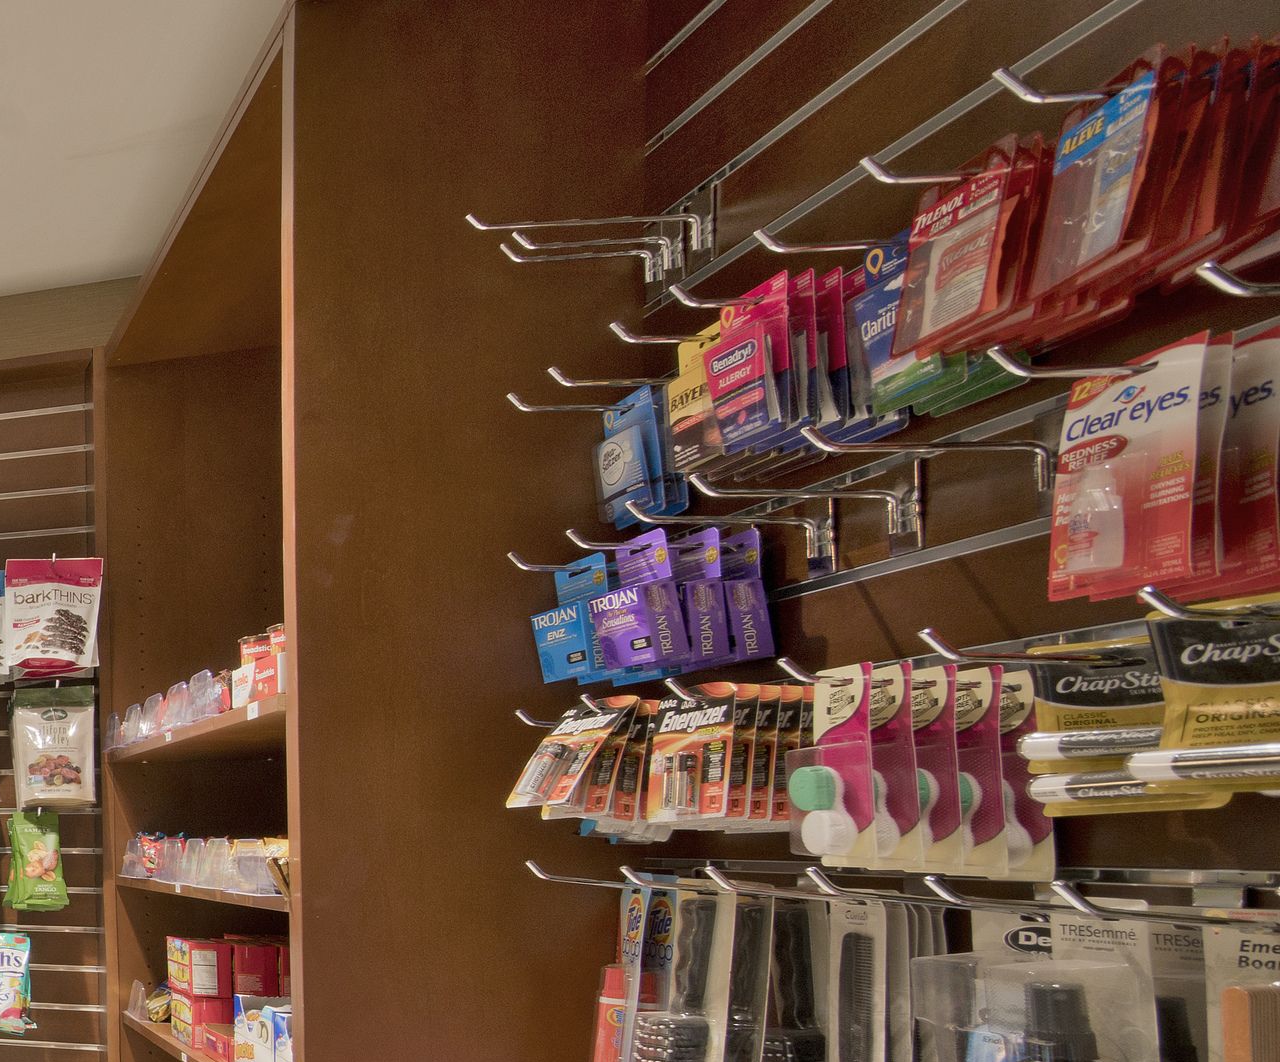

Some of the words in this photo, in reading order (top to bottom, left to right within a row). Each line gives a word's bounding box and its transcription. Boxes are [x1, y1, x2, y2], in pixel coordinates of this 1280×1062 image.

[1061, 116, 1104, 157] ALEVE
[914, 192, 965, 233] TYLENOL
[712, 344, 752, 372] Benadryl
[718, 365, 752, 390] ALLERGY
[1066, 406, 1127, 442] Clear
[1129, 386, 1189, 423] eyes
[1061, 438, 1118, 464] REDNESS
[1068, 453, 1109, 471] RELIEF
[1150, 476, 1185, 491] DRYNESS
[1150, 486, 1185, 499] BURNING
[1143, 493, 1190, 509] IRRITATIONS
[13, 589, 93, 605] barkTHINS
[590, 587, 640, 614] TROJAN
[532, 606, 579, 631] TROJAN
[602, 614, 635, 630] Sensations
[547, 627, 566, 642] ENZ
[654, 614, 674, 656] TROJAN
[702, 614, 715, 657] TROJAN
[746, 614, 759, 656] TROJAN
[1129, 688, 1146, 696] SKIN
[554, 710, 618, 736] Energizer
[659, 704, 726, 734] Energizer
[1063, 711, 1107, 721] CLASSIC
[1064, 717, 1118, 727] ORIGINAL
[1192, 725, 1236, 738] PROTECTS
[627, 906, 642, 939] Tide
[650, 906, 673, 942] Tide
[1060, 923, 1137, 940] TRESemmé
